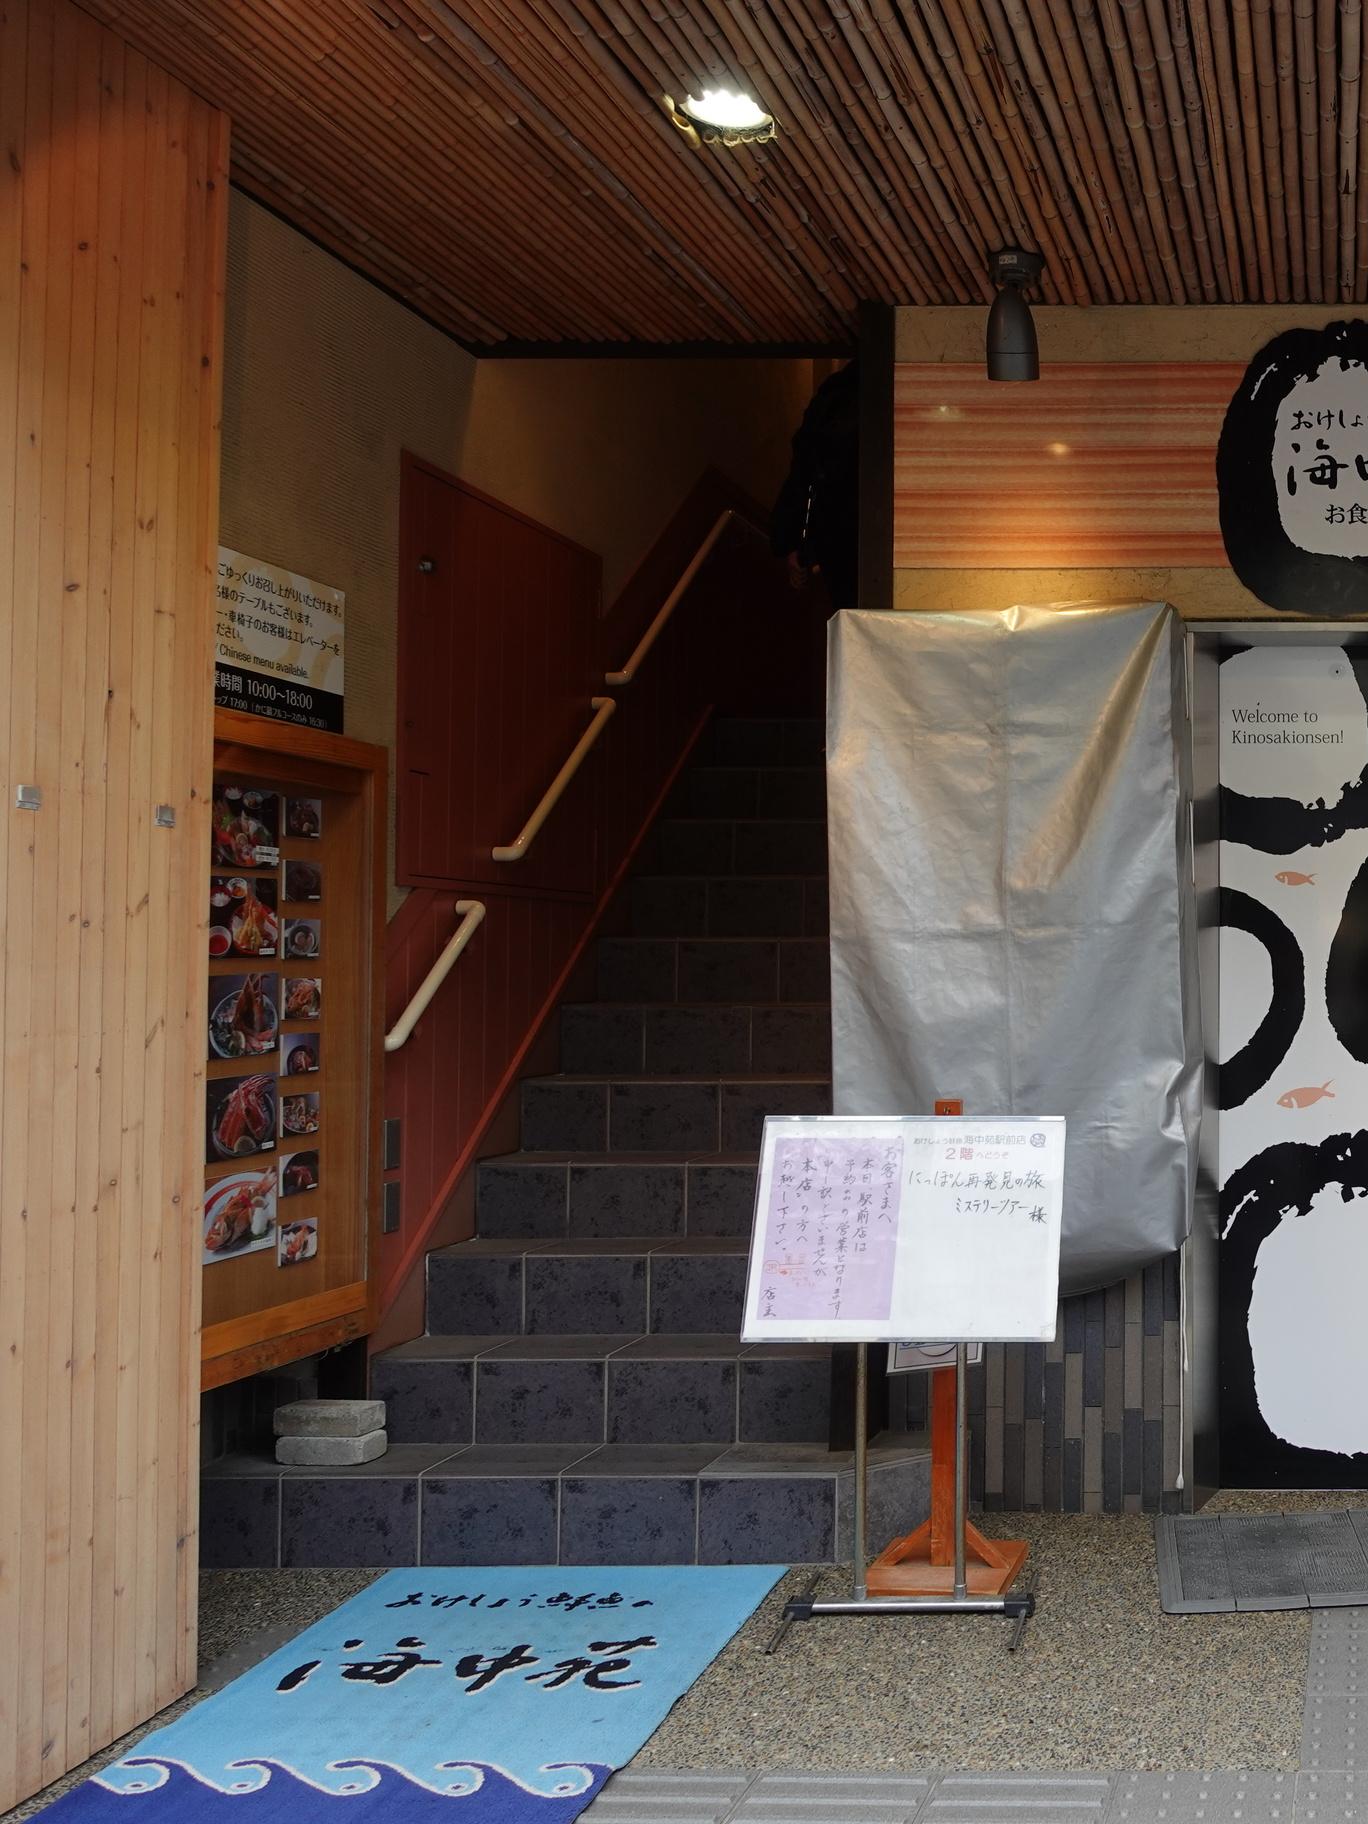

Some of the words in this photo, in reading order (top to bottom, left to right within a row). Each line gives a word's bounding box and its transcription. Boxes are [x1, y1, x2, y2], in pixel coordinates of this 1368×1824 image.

[219, 643, 252, 664] Chinese
[252, 655, 275, 671] menu
[1231, 708, 1299, 723] Welcome
[1303, 710, 1318, 723] to
[1231, 729, 1344, 744] Kinosakionsen!
[908, 1169, 1046, 1191] にっぽん再発見の旅
[274, 1634, 660, 1696] 海中苑
